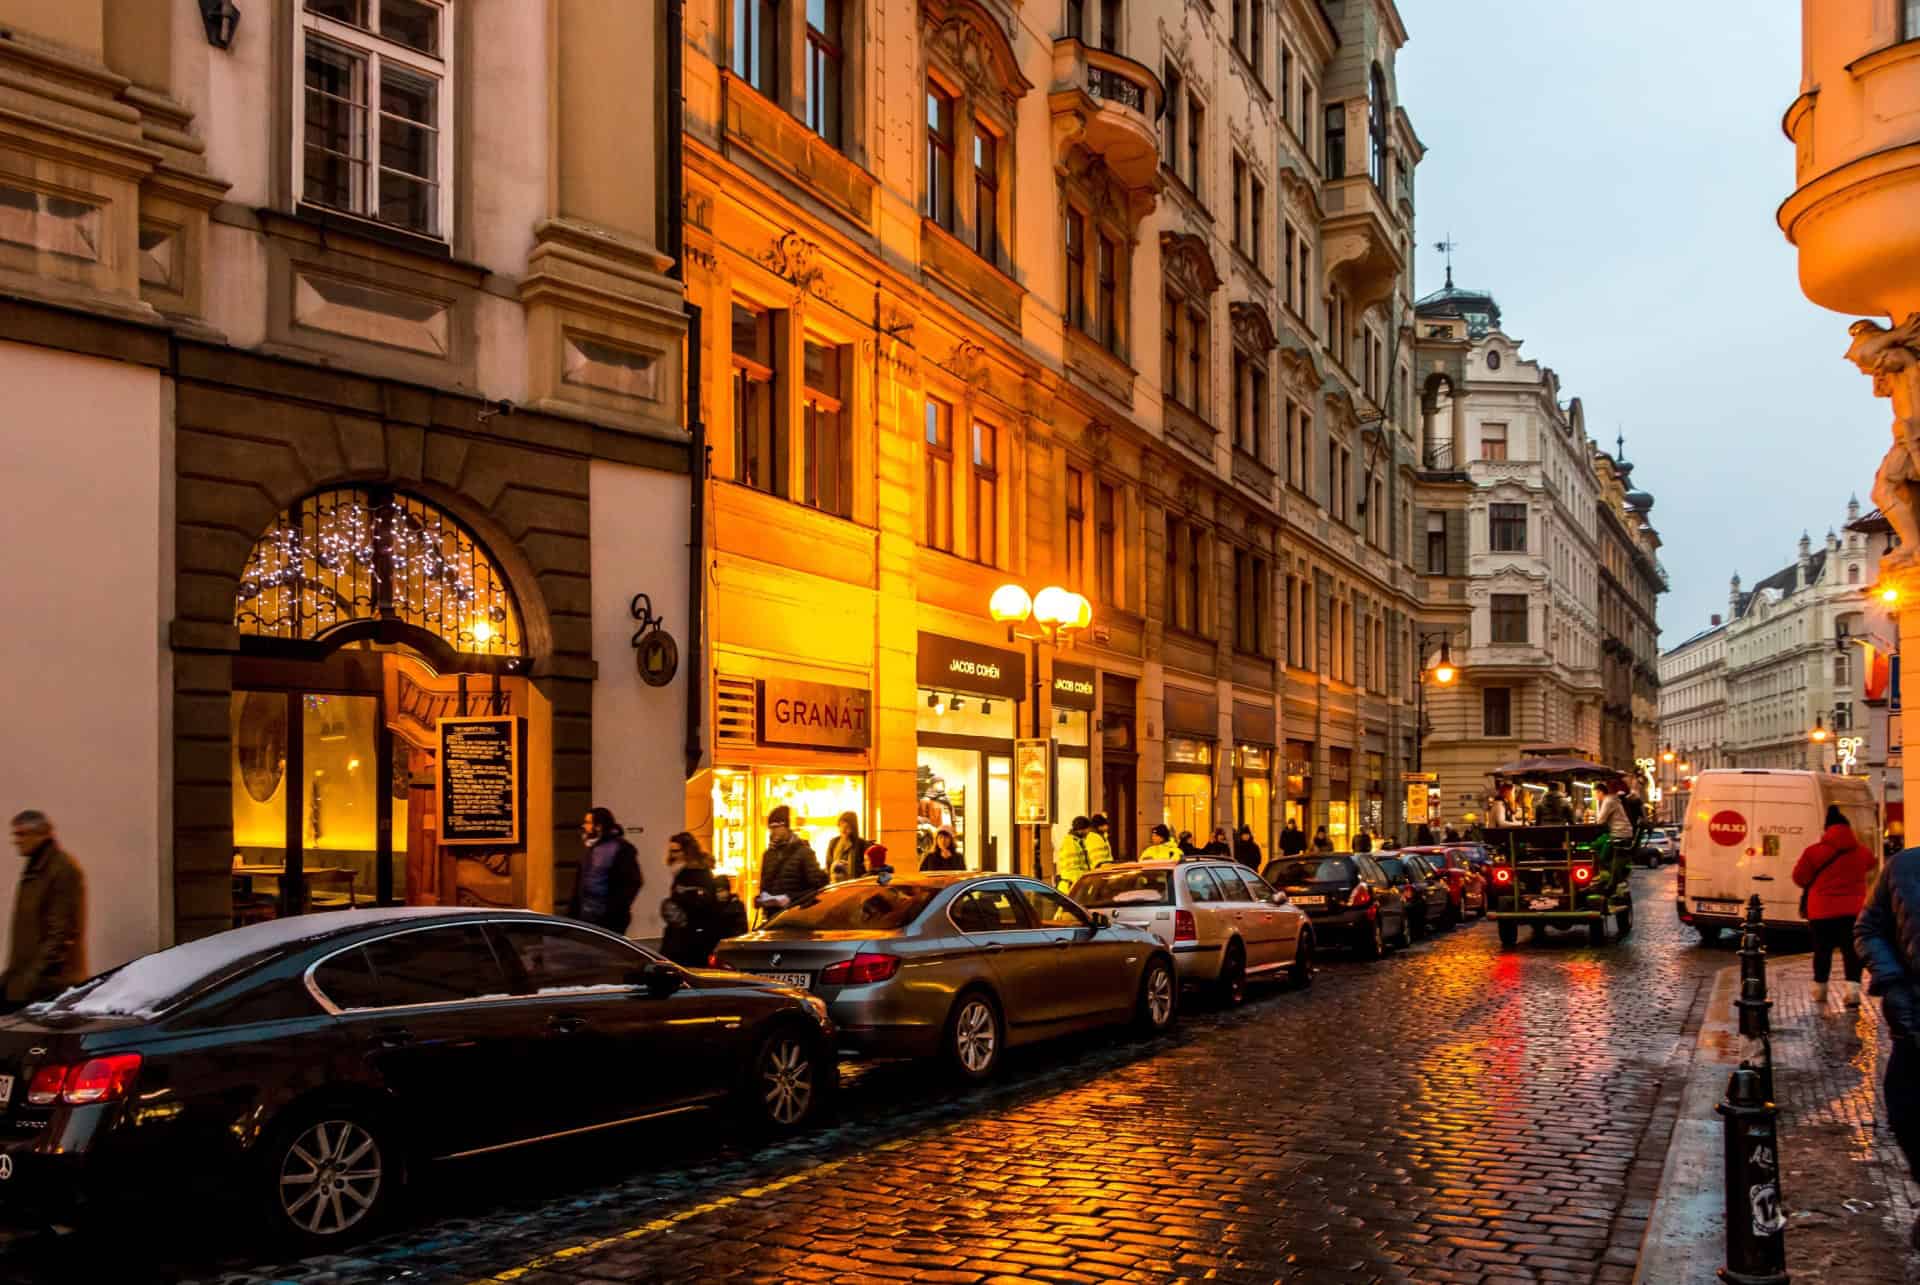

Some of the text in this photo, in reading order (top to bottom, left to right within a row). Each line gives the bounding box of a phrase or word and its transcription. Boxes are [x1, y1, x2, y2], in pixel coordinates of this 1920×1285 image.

[949, 658, 975, 675] JACOB
[1054, 678, 1074, 692] JACOB
[775, 697, 866, 731] GRANÁT
[1710, 823, 1746, 834] MAXI
